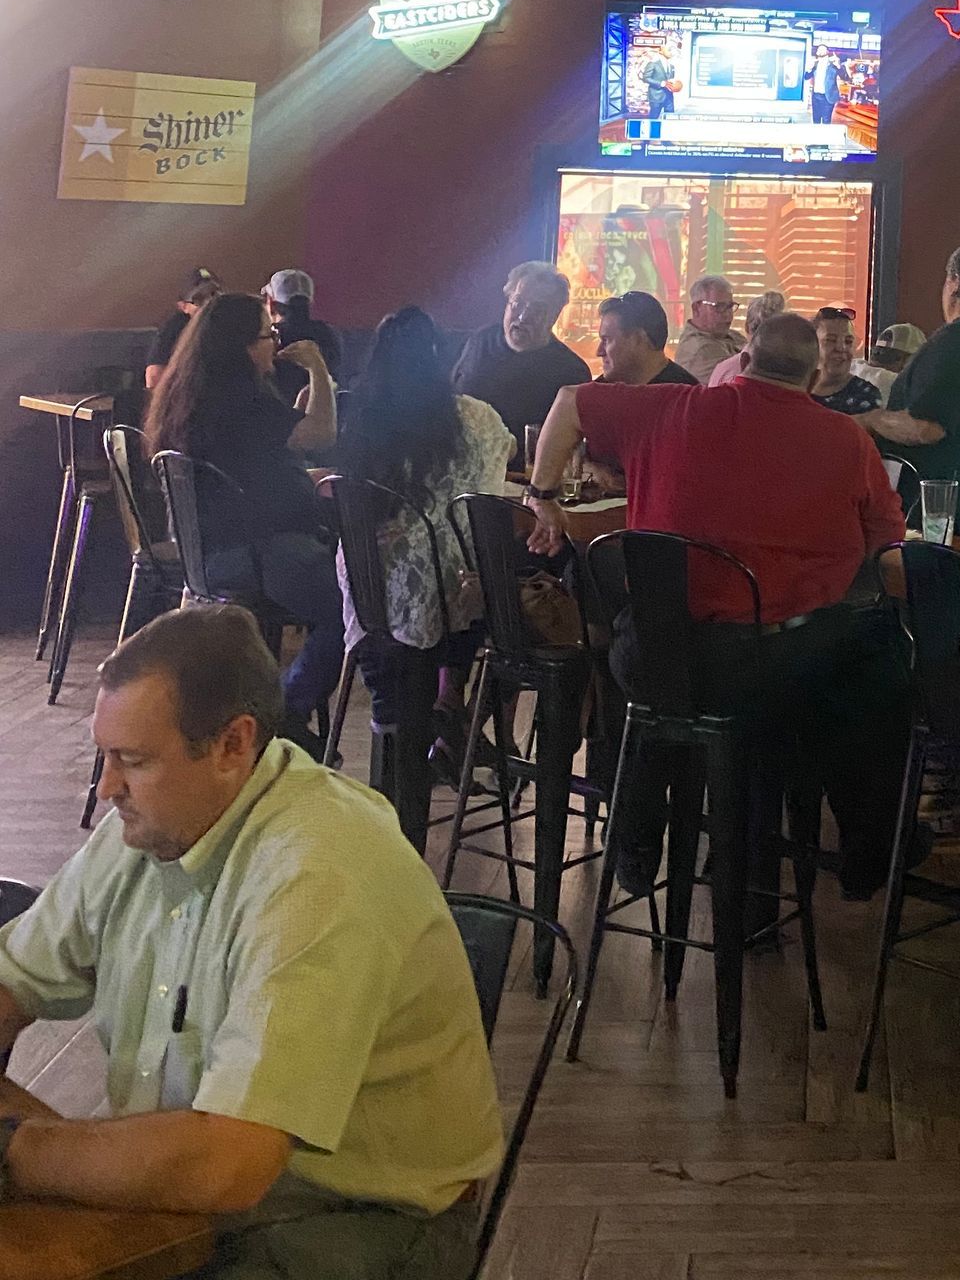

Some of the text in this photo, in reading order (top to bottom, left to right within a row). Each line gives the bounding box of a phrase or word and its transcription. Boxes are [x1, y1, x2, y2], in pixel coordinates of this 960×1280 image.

[384, 0, 490, 30] EASTCIDERS
[139, 109, 245, 153] Shiner
[155, 146, 226, 175] BOCK
